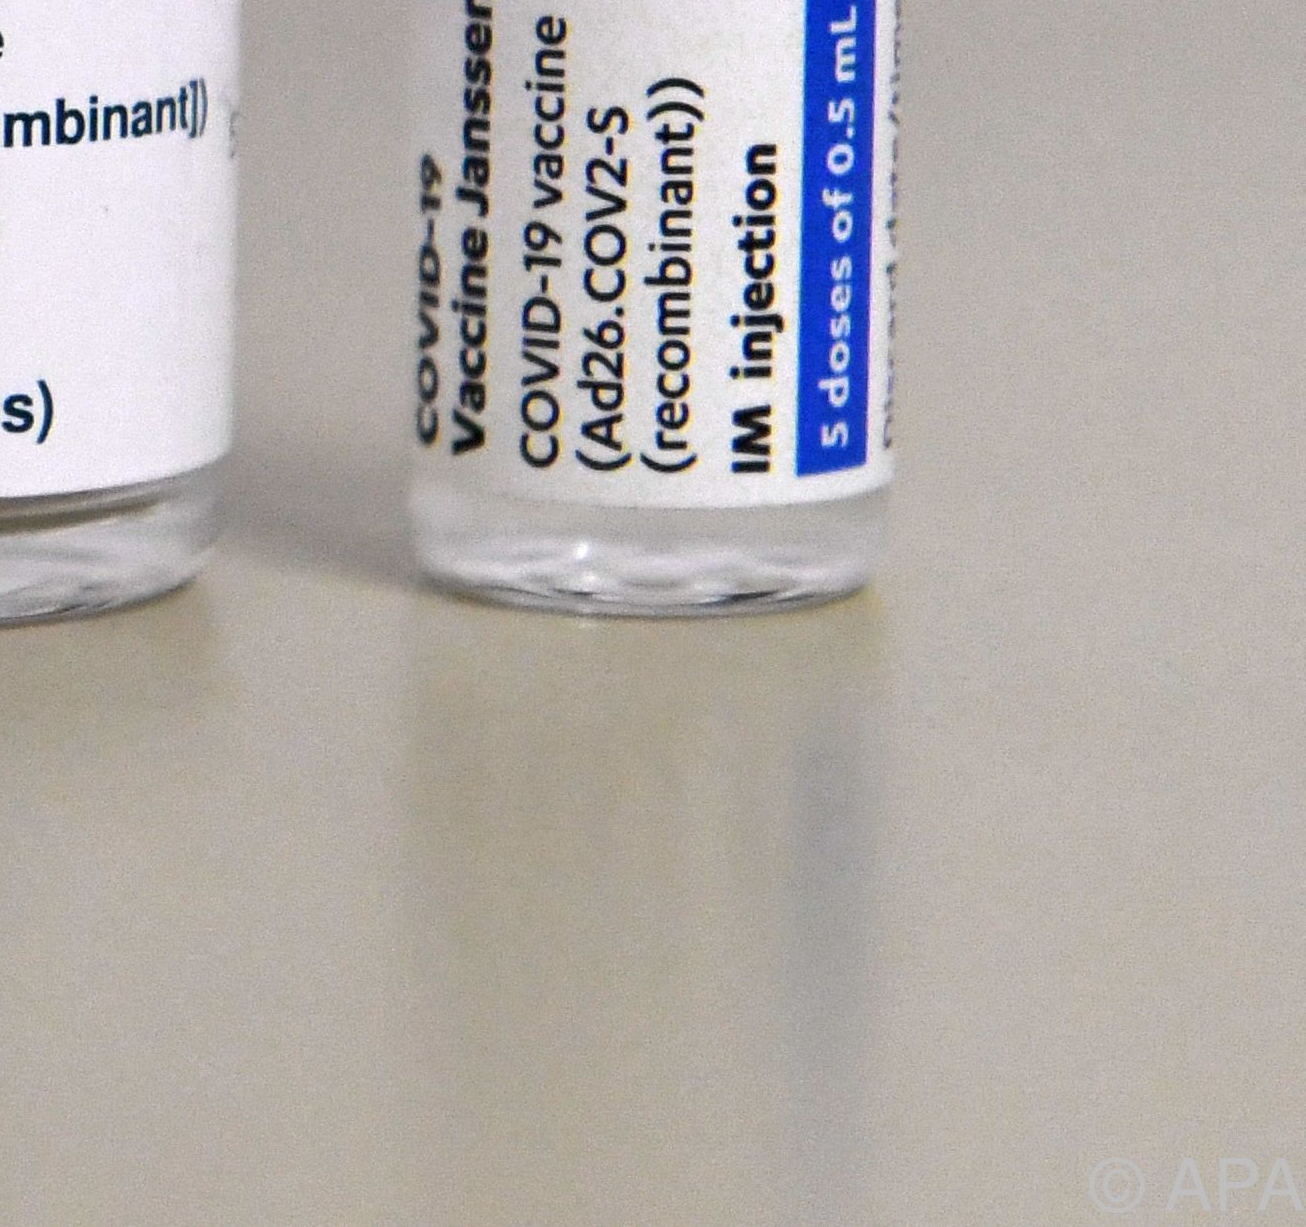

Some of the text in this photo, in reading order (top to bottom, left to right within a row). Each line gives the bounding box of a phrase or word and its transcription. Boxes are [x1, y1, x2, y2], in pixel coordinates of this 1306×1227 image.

[415, 152, 443, 450] COVID-19
[450, 227, 488, 457] Vaccine
[519, 14, 568, 469] COVID-19 vaccine
[574, 104, 632, 472] (Ad26.COV2-S
[640, 77, 705, 474] (recombinant))
[730, 142, 787, 476] IM injection
[818, 5, 858, 450] 5 doses of 0.5 mL
